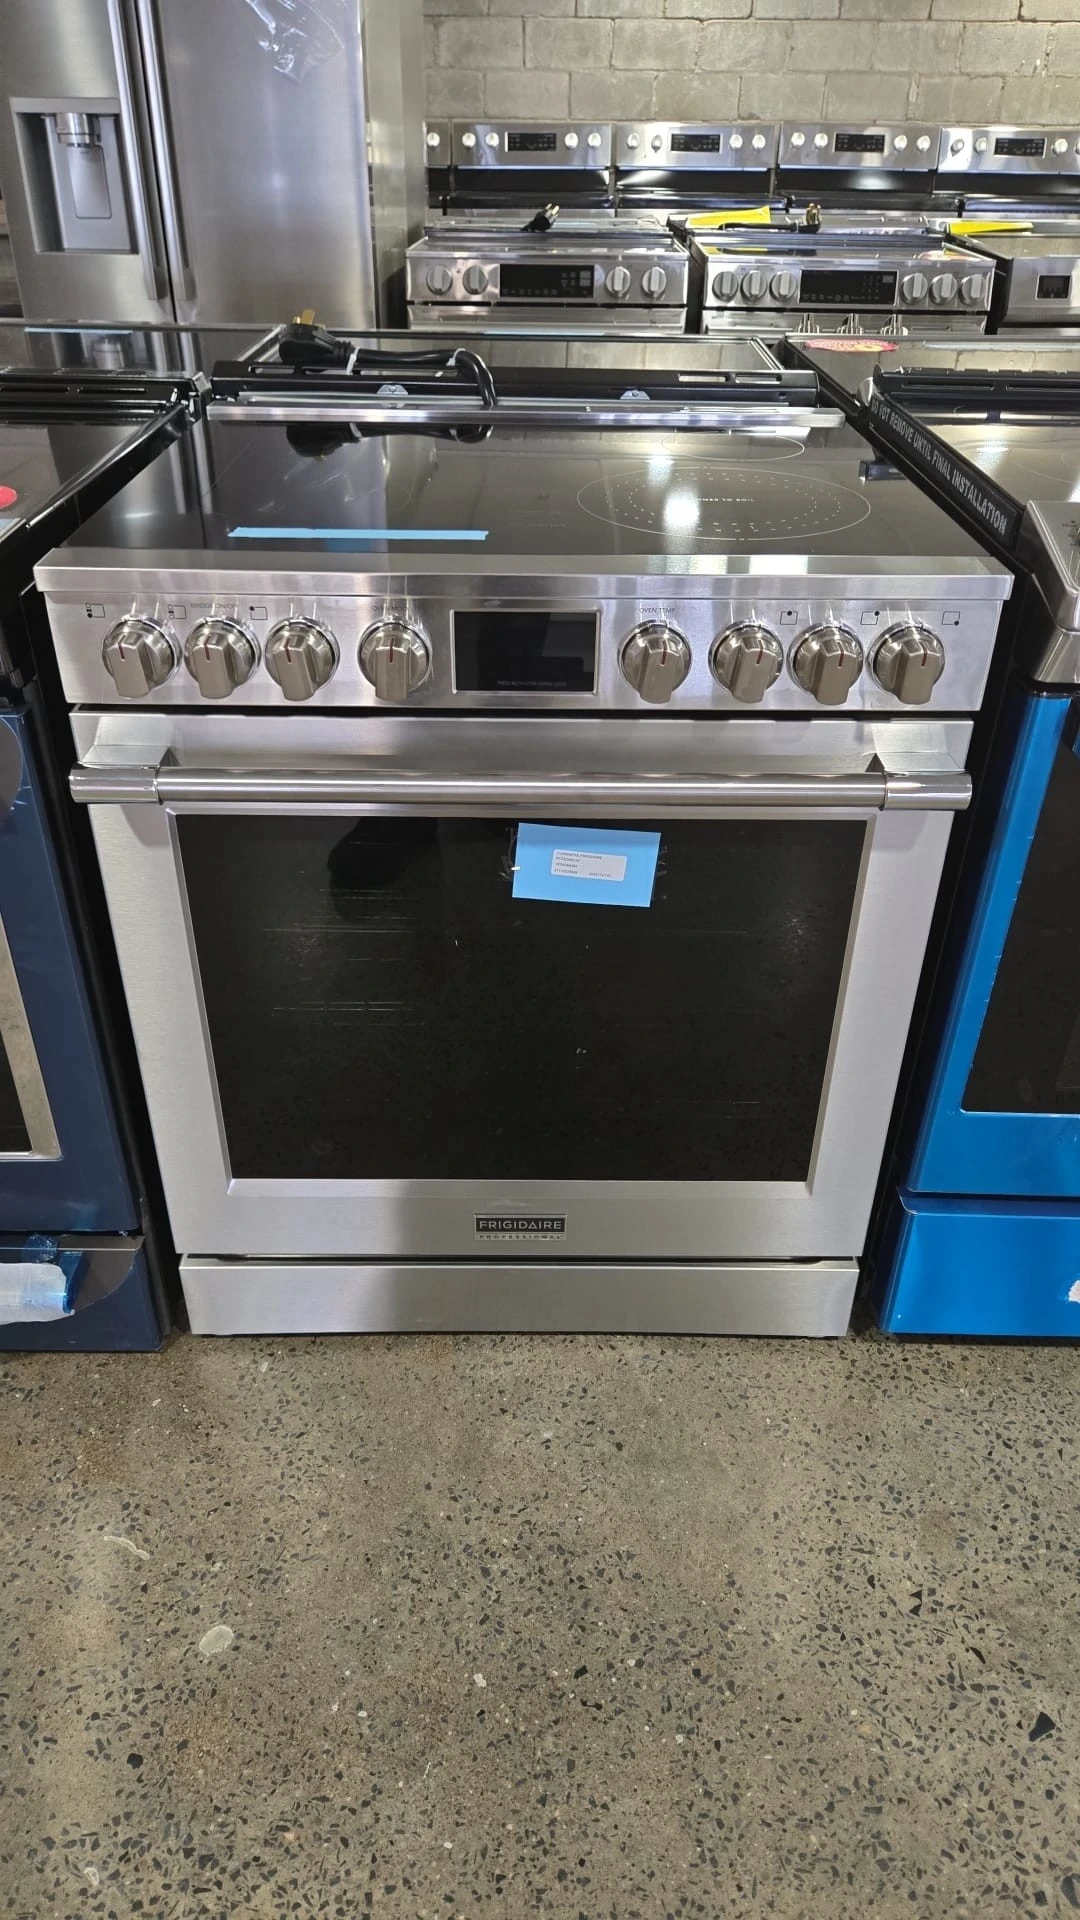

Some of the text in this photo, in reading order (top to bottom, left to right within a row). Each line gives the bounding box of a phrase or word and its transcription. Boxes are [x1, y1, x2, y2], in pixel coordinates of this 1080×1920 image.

[889, 411, 914, 443] REMOVE
[914, 431, 932, 460] UNTIL
[932, 449, 951, 480] FINAL
[951, 468, 1008, 536] INSTALLATION
[479, 1220, 562, 1230] FRIGIDAIRE
